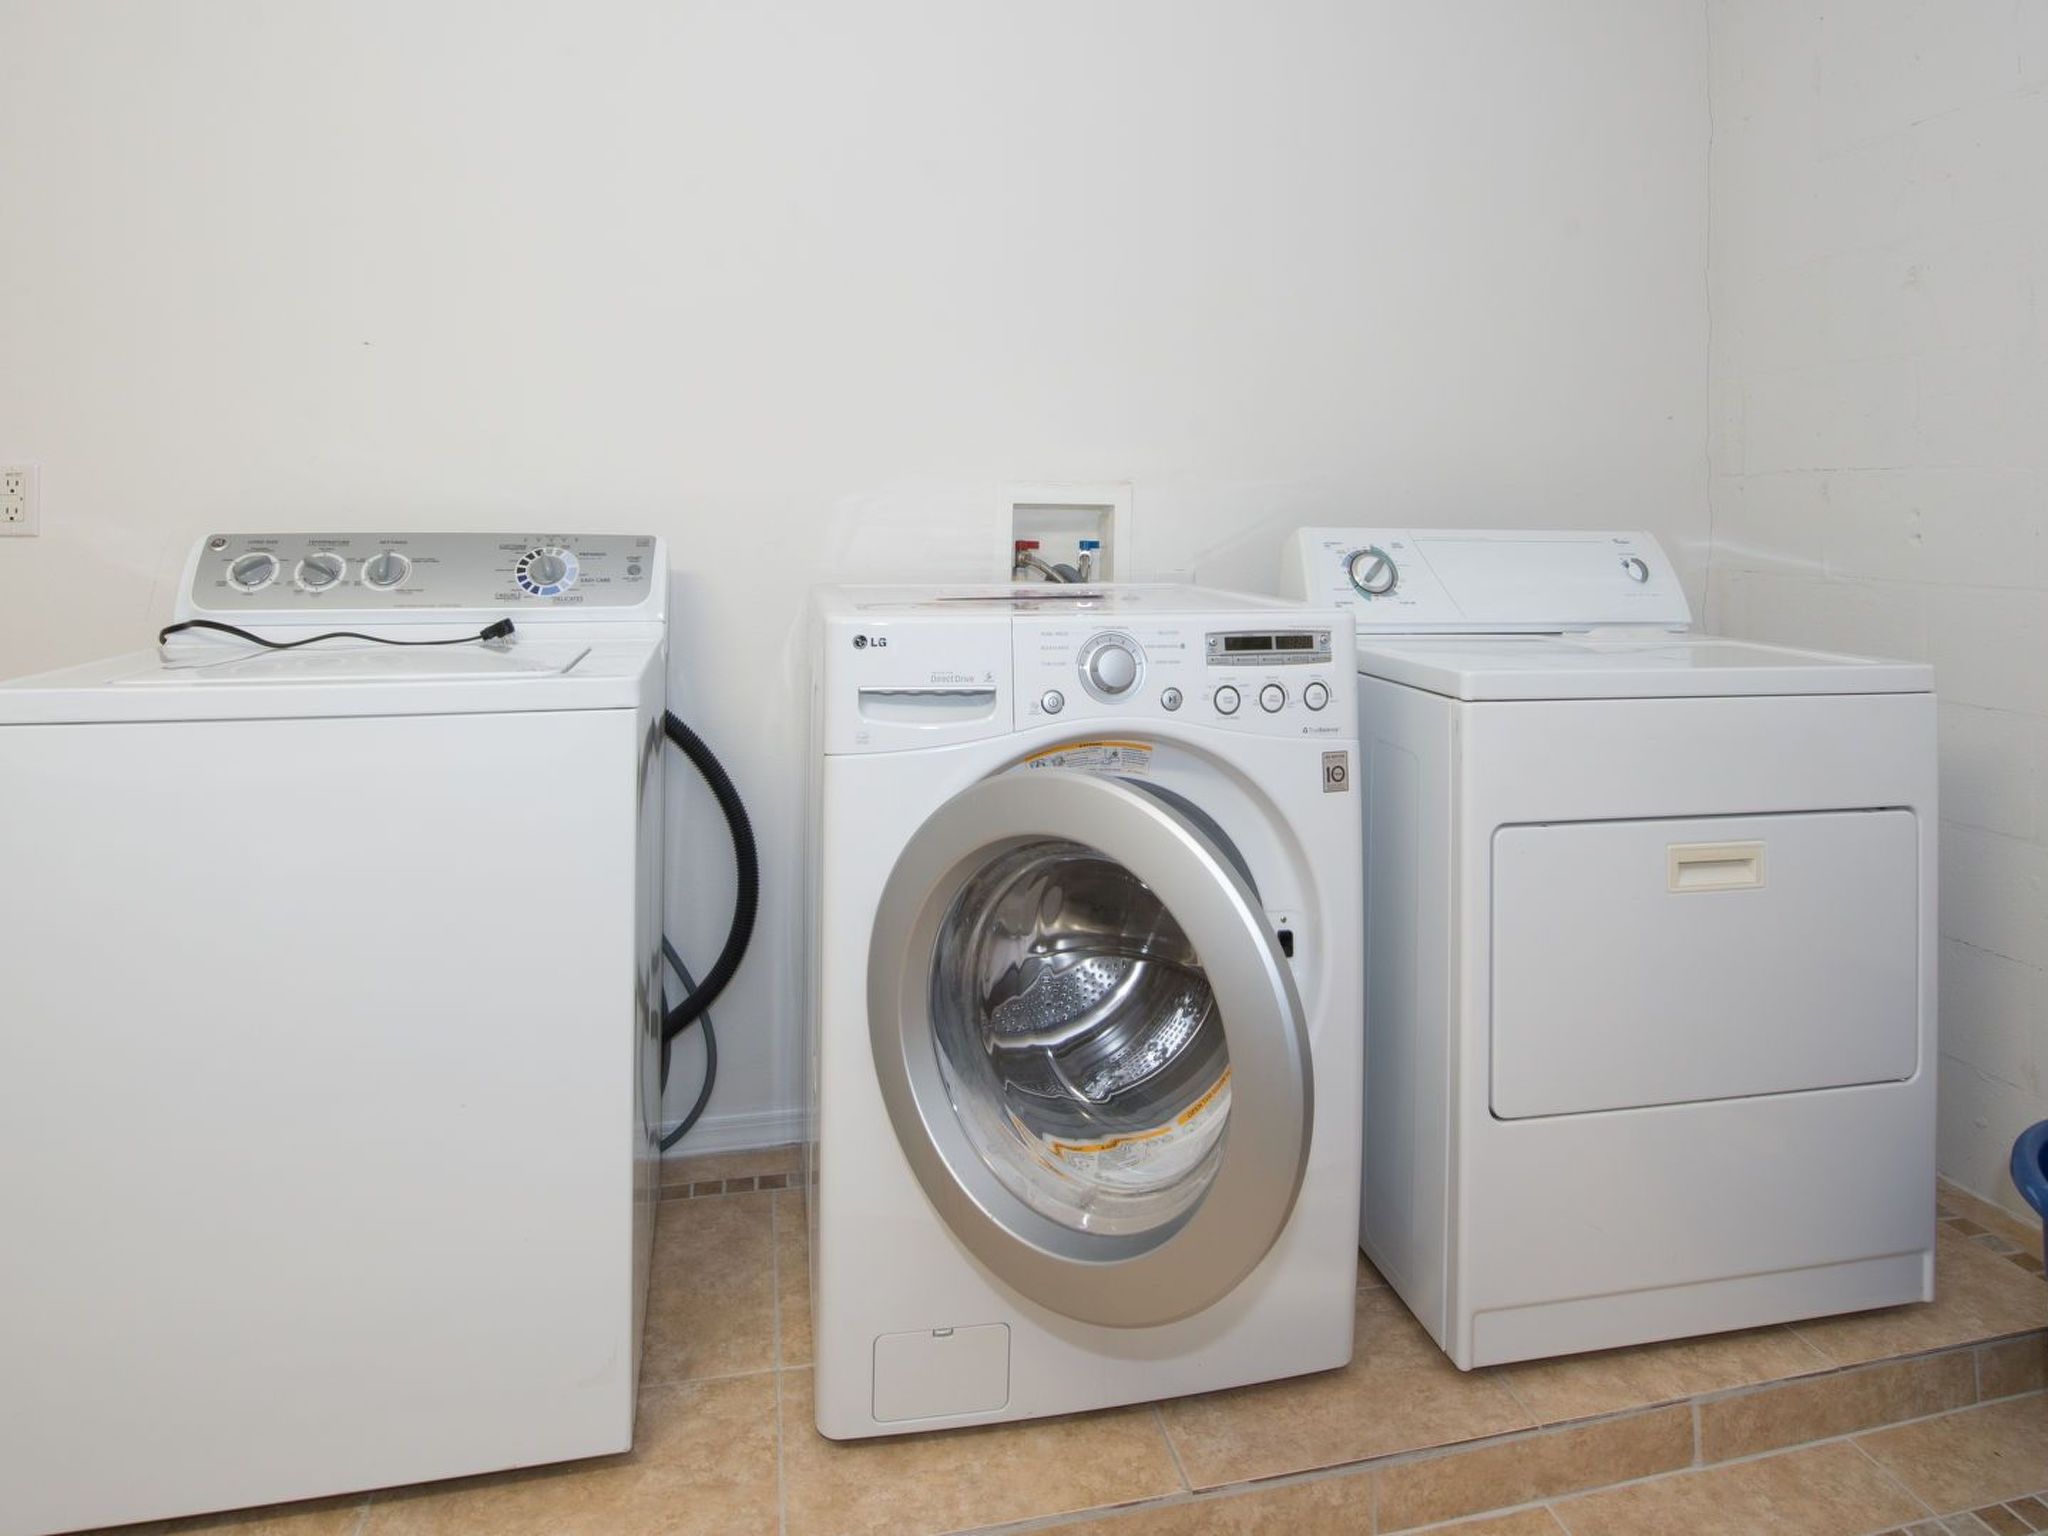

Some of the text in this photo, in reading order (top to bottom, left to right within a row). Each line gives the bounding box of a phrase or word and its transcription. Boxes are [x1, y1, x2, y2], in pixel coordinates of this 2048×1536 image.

[870, 636, 888, 648] LG
[930, 673, 975, 683] Direct Drive
